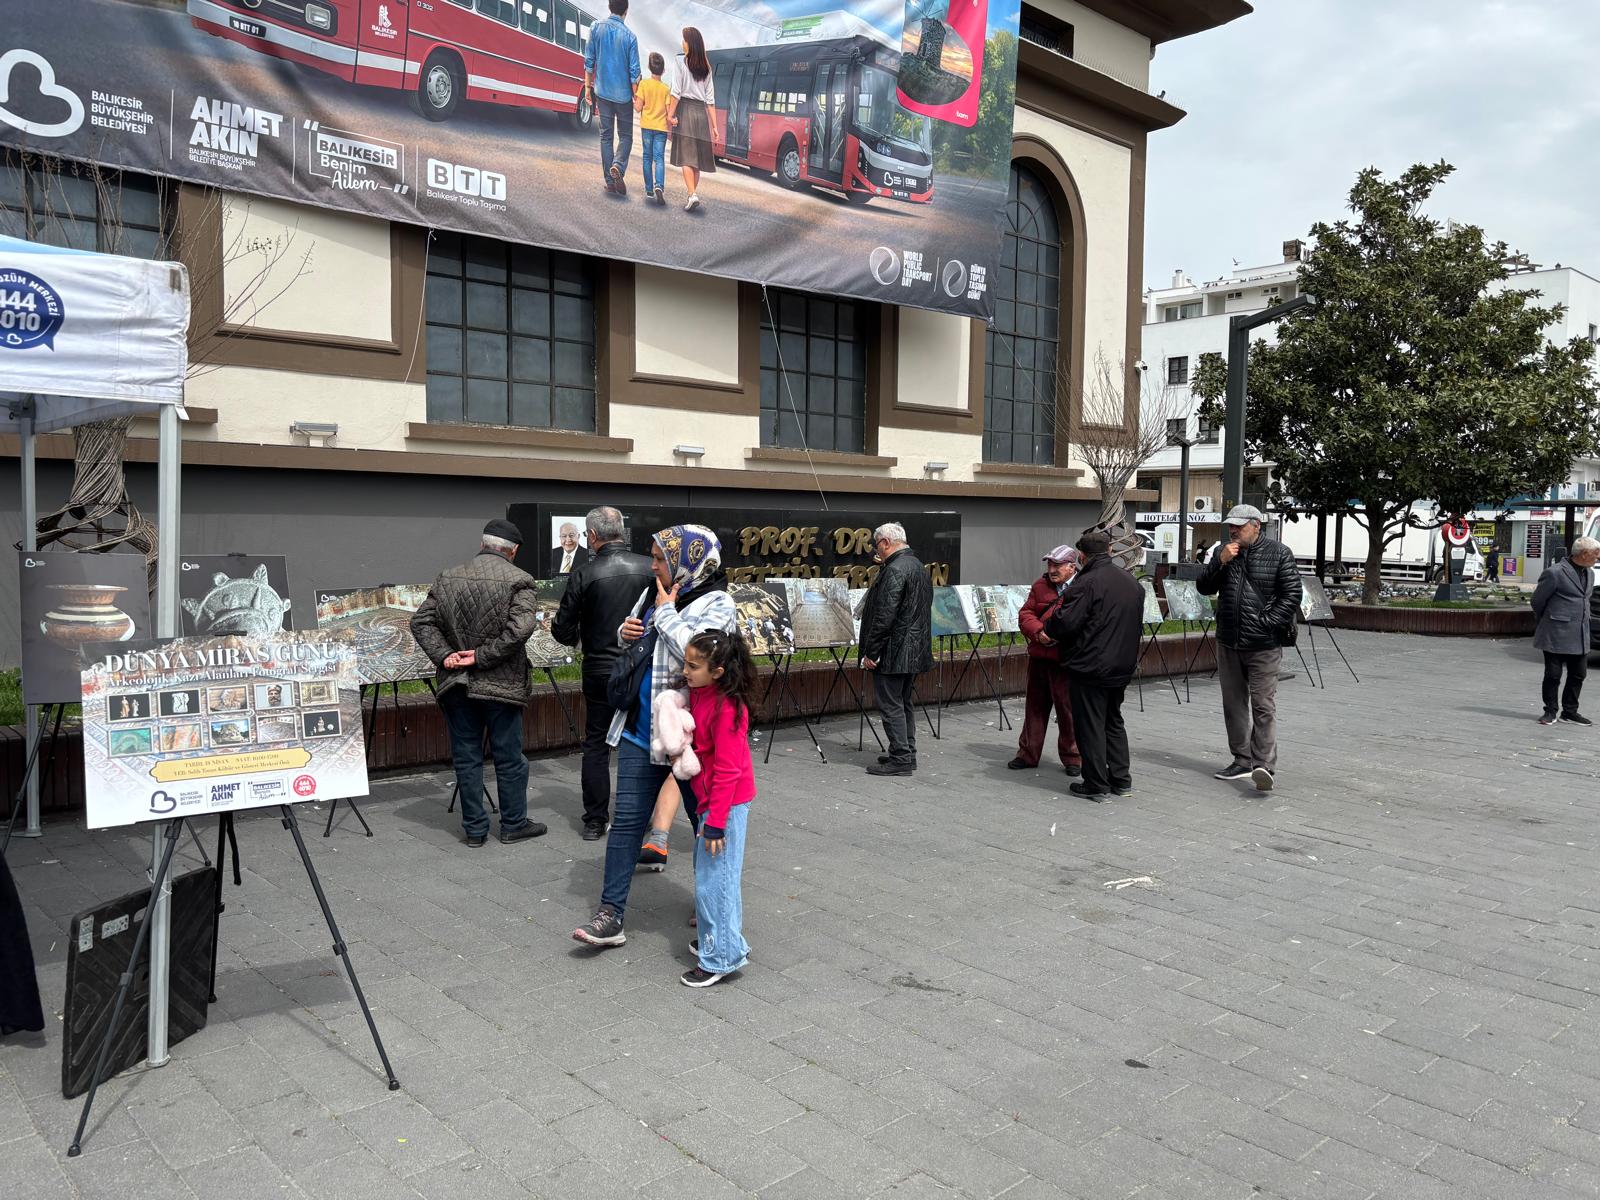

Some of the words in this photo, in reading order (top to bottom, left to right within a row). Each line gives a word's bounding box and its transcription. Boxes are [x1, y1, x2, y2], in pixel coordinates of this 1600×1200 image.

[240, 22, 250, 32] BTT
[251, 25, 259, 35] 01
[91, 89, 143, 110] BALIKESİR
[91, 102, 154, 125] BÜYÜKŞEHİR
[190, 95, 284, 138] AHMET
[956, 110, 969, 120] tam
[91, 115, 147, 135] BELEDİYESİ
[189, 120, 259, 158] AKIN
[189, 147, 219, 160] BALIKESİR
[219, 152, 256, 168] BÜYÜKŞEHİR
[319, 139, 395, 167] BALIKESİR
[217, 159, 243, 172] BAŞKANI
[320, 154, 367, 176] Benim
[331, 169, 380, 191] Ailem
[430, 161, 503, 198] BTT
[426, 189, 458, 202] Balıkesir
[459, 195, 479, 207] Toplu
[479, 199, 507, 212] Taşıma
[903, 250, 923, 262] WORLD
[903, 259, 922, 271] PUBLIC
[902, 268, 933, 283] TRANSPORT
[969, 272, 985, 284] TOPLU
[970, 263, 986, 275] DÜNYA
[901, 277, 913, 288] DAY
[28, 280, 61, 317] MERKEZİ
[1144, 514, 1169, 522] HOTEL
[739, 525, 824, 558] PROF.
[105, 650, 191, 673] DÜNYA
[196, 645, 270, 667] MİRAS
[275, 638, 337, 662] GÜNÜ
[108, 673, 169, 688] Arkeolojik
[204, 668, 249, 681] Alanları
[211, 782, 241, 794] AHMET
[211, 791, 234, 802] AKIN
